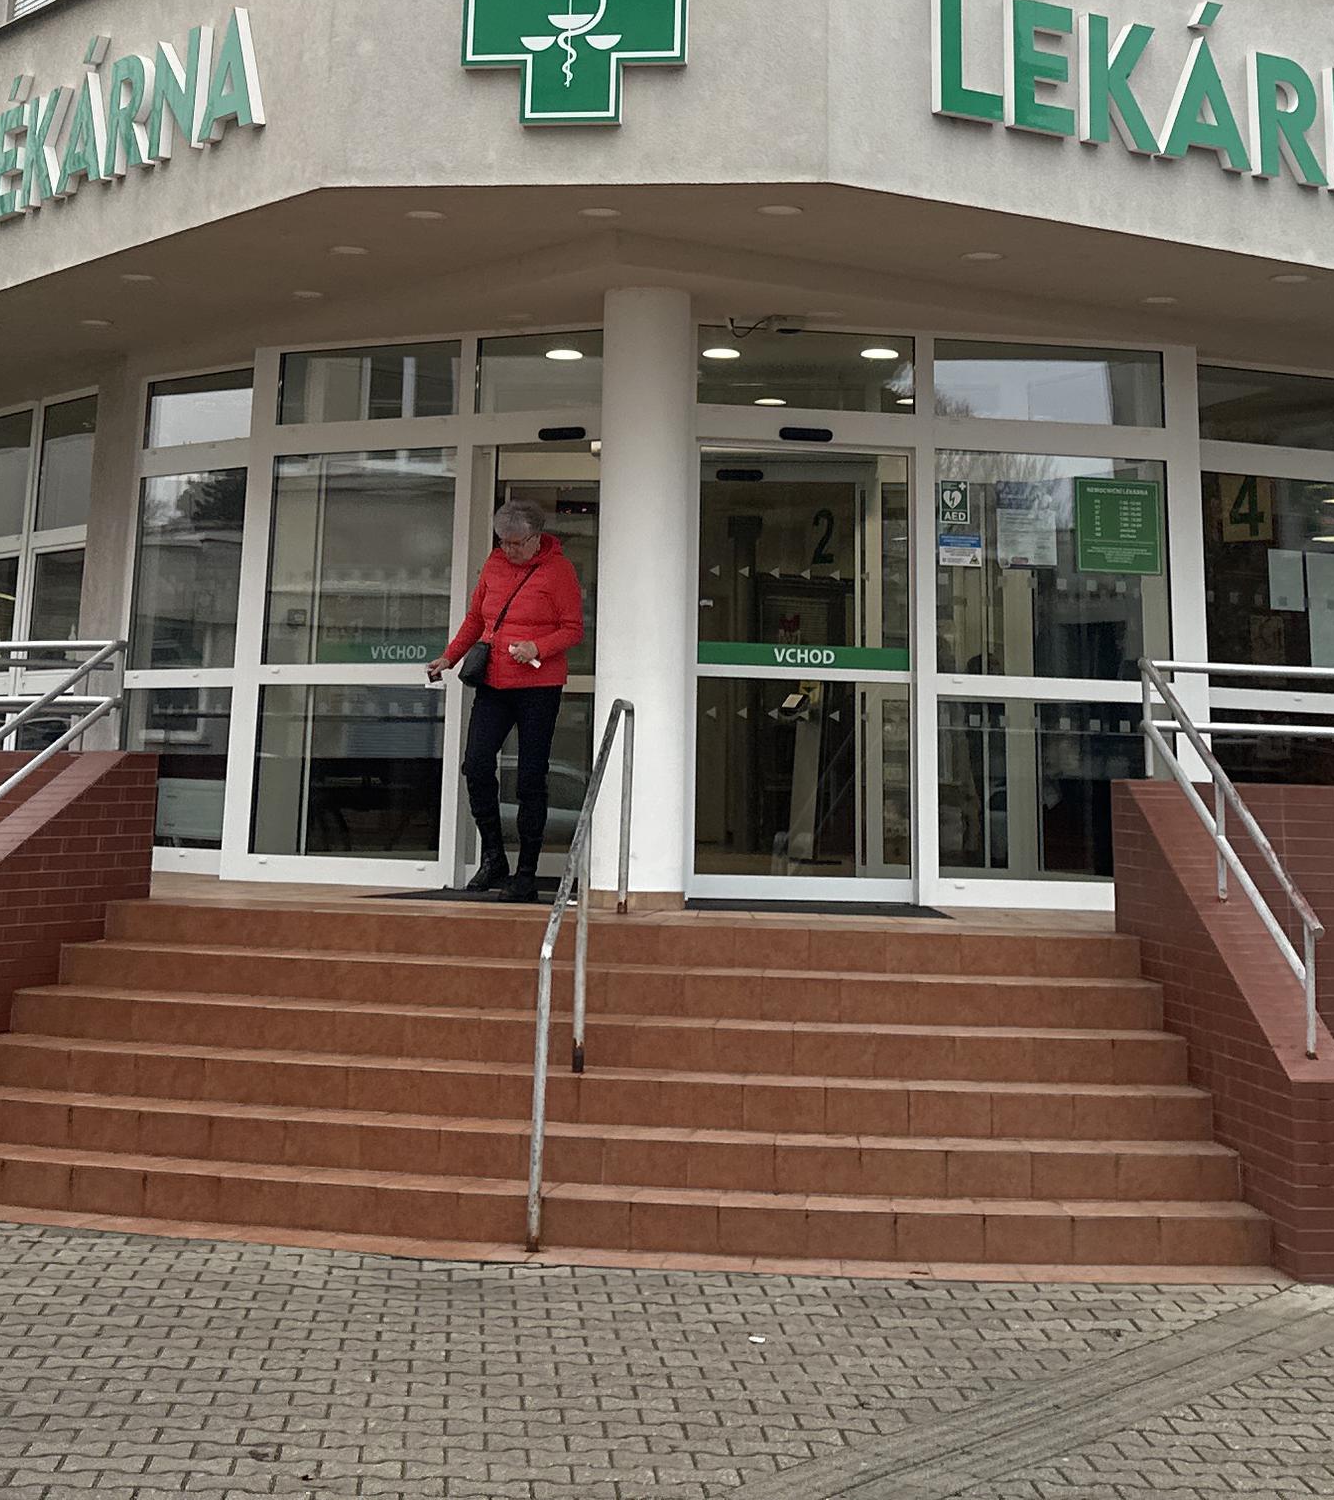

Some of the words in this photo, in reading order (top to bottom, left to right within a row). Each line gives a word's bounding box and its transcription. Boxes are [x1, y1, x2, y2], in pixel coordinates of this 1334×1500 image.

[1229, 475, 1265, 537] 4
[944, 511, 966, 521] AED
[811, 508, 834, 565] 2
[370, 642, 427, 659] VÝCHOD
[773, 647, 836, 664] VCHOD
